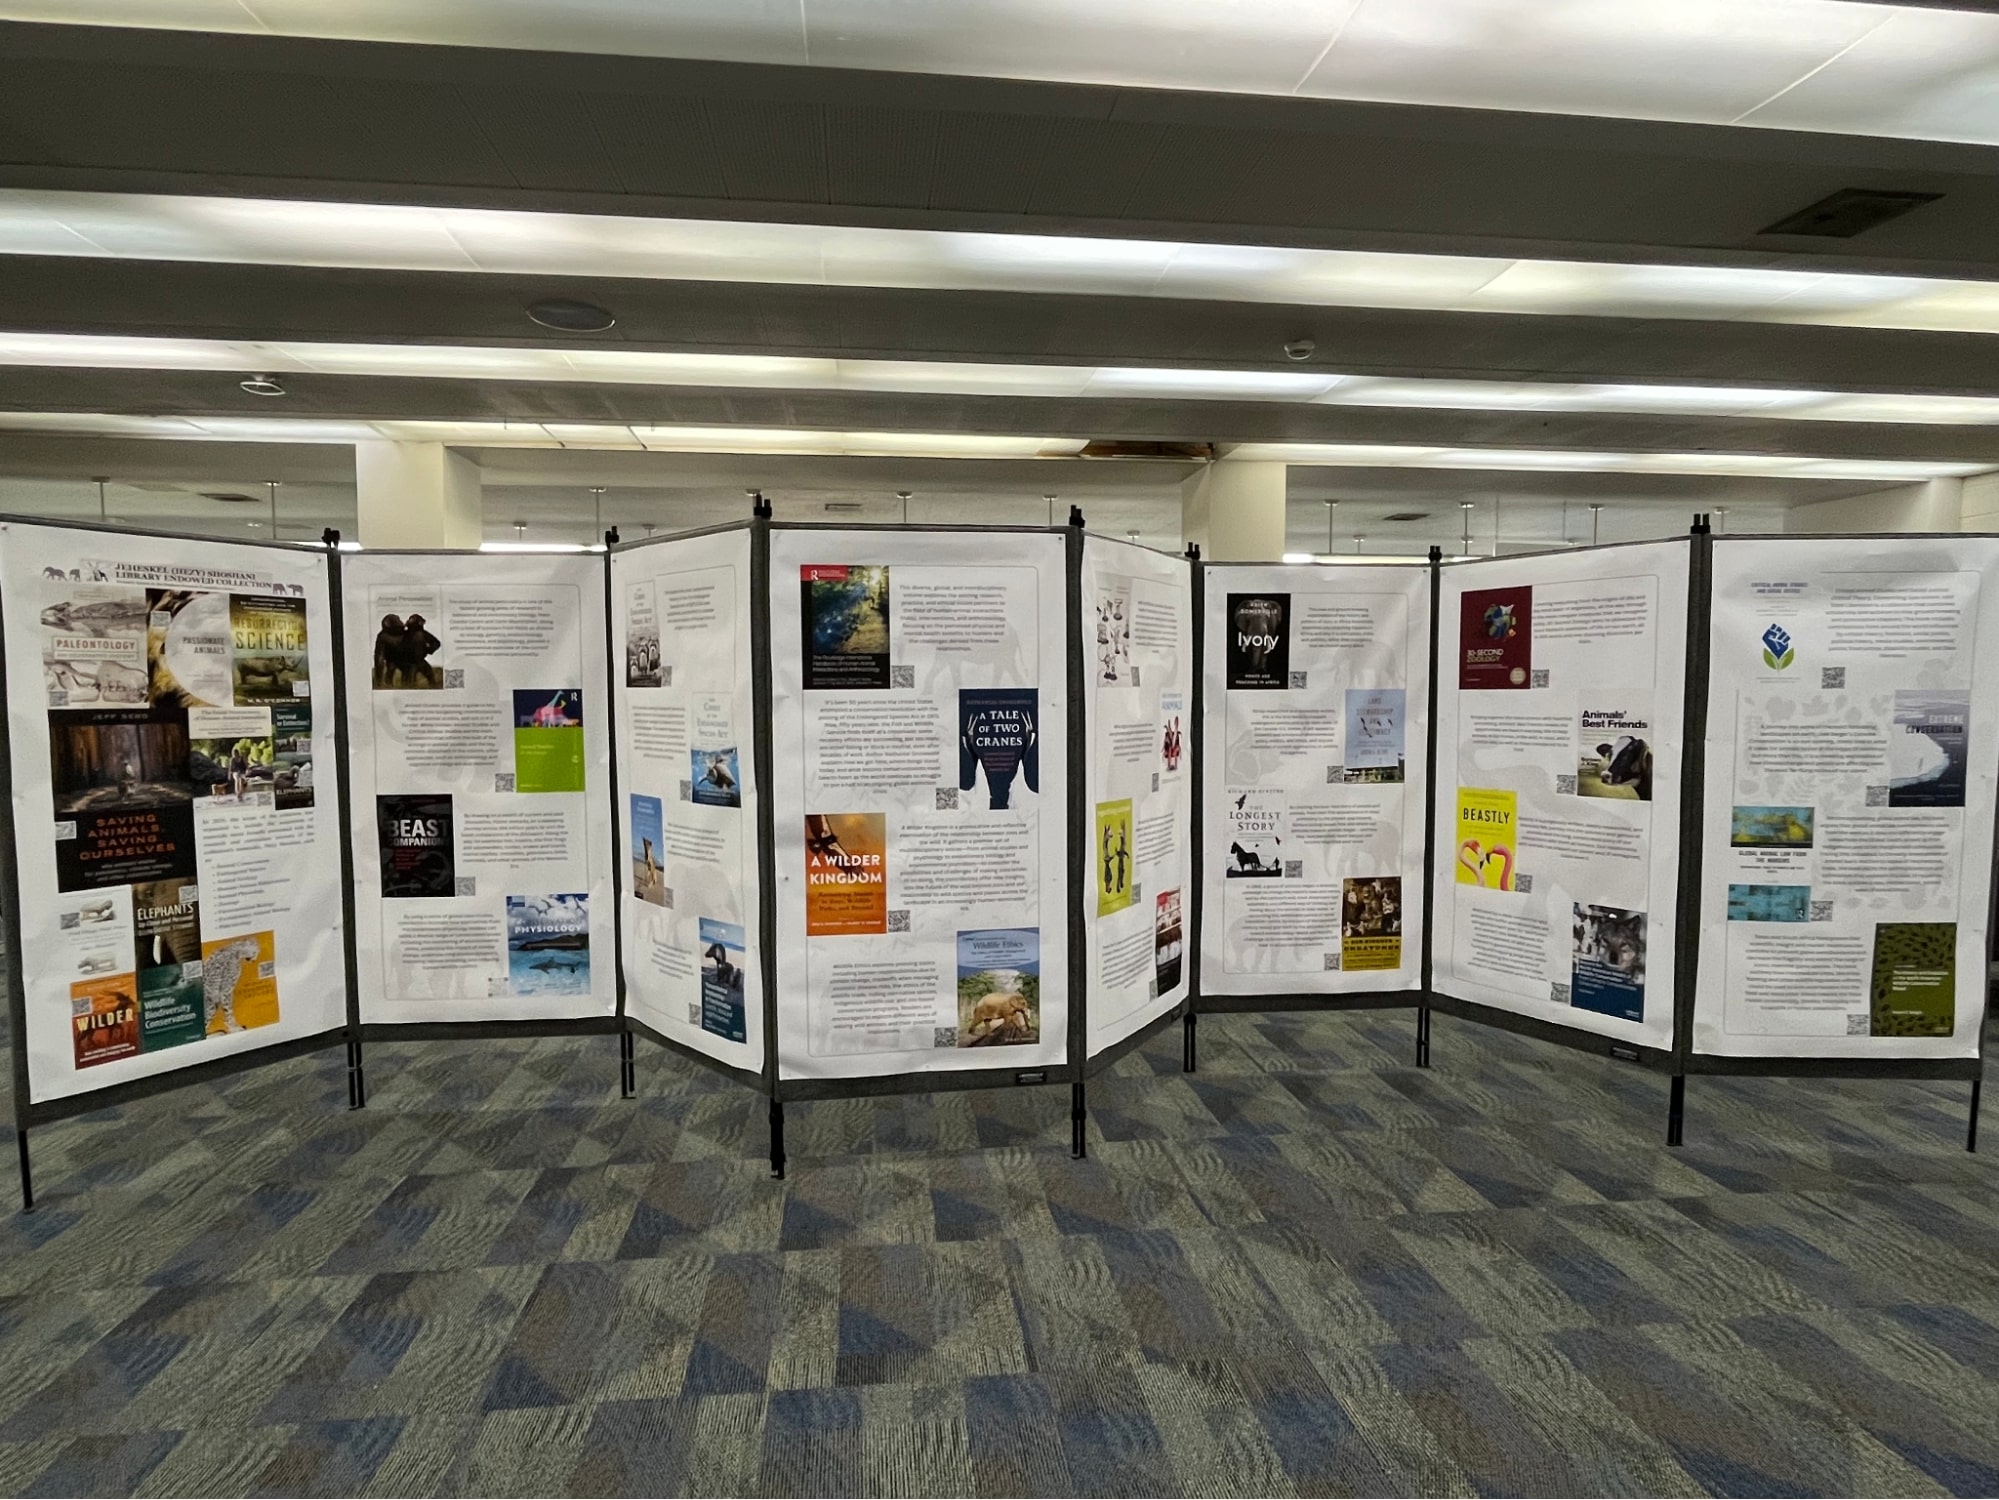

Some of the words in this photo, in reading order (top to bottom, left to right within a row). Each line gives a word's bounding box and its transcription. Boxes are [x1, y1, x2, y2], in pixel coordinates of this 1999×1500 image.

[115, 571, 161, 581] LIBRARY
[164, 574, 215, 585] ENDOWED
[215, 578, 272, 589] COLLECTION
[207, 570, 256, 580] SHOSHANI
[233, 616, 306, 631] RESURRECTION
[56, 639, 135, 650] PALEONTOLOGY
[182, 637, 225, 645] PASSIONATE
[235, 631, 306, 651] SCIENCE
[1238, 631, 1280, 650] Ivory
[194, 646, 225, 654] ANIMALS
[979, 712, 986, 720] A
[989, 710, 1020, 720] TALE
[1929, 714, 1964, 724] EXTREME
[978, 725, 990, 733] OF
[993, 723, 1020, 733] TWO
[1582, 719, 1605, 728] Best
[1607, 719, 1648, 729] Friends
[1905, 724, 1963, 734] CONSERVATION
[975, 736, 1023, 747] CRANES
[96, 814, 156, 827] SAVING
[1229, 811, 1281, 820] LONGEST
[1463, 807, 1510, 824] BEASTLY
[1237, 821, 1275, 831] STORY
[97, 835, 157, 848] SAVING
[79, 842, 176, 860] OURSELVES
[811, 855, 822, 867] A
[825, 854, 881, 867] WILDER
[809, 872, 882, 885] KINGDOM
[137, 903, 194, 921] ELEPHANTS
[514, 924, 581, 934] PHYSIOLOGY
[144, 996, 175, 1010] Wildlife
[144, 1004, 191, 1020] Biodiversity
[76, 1007, 134, 1032] WILDER
[145, 1012, 197, 1030] Conservation
